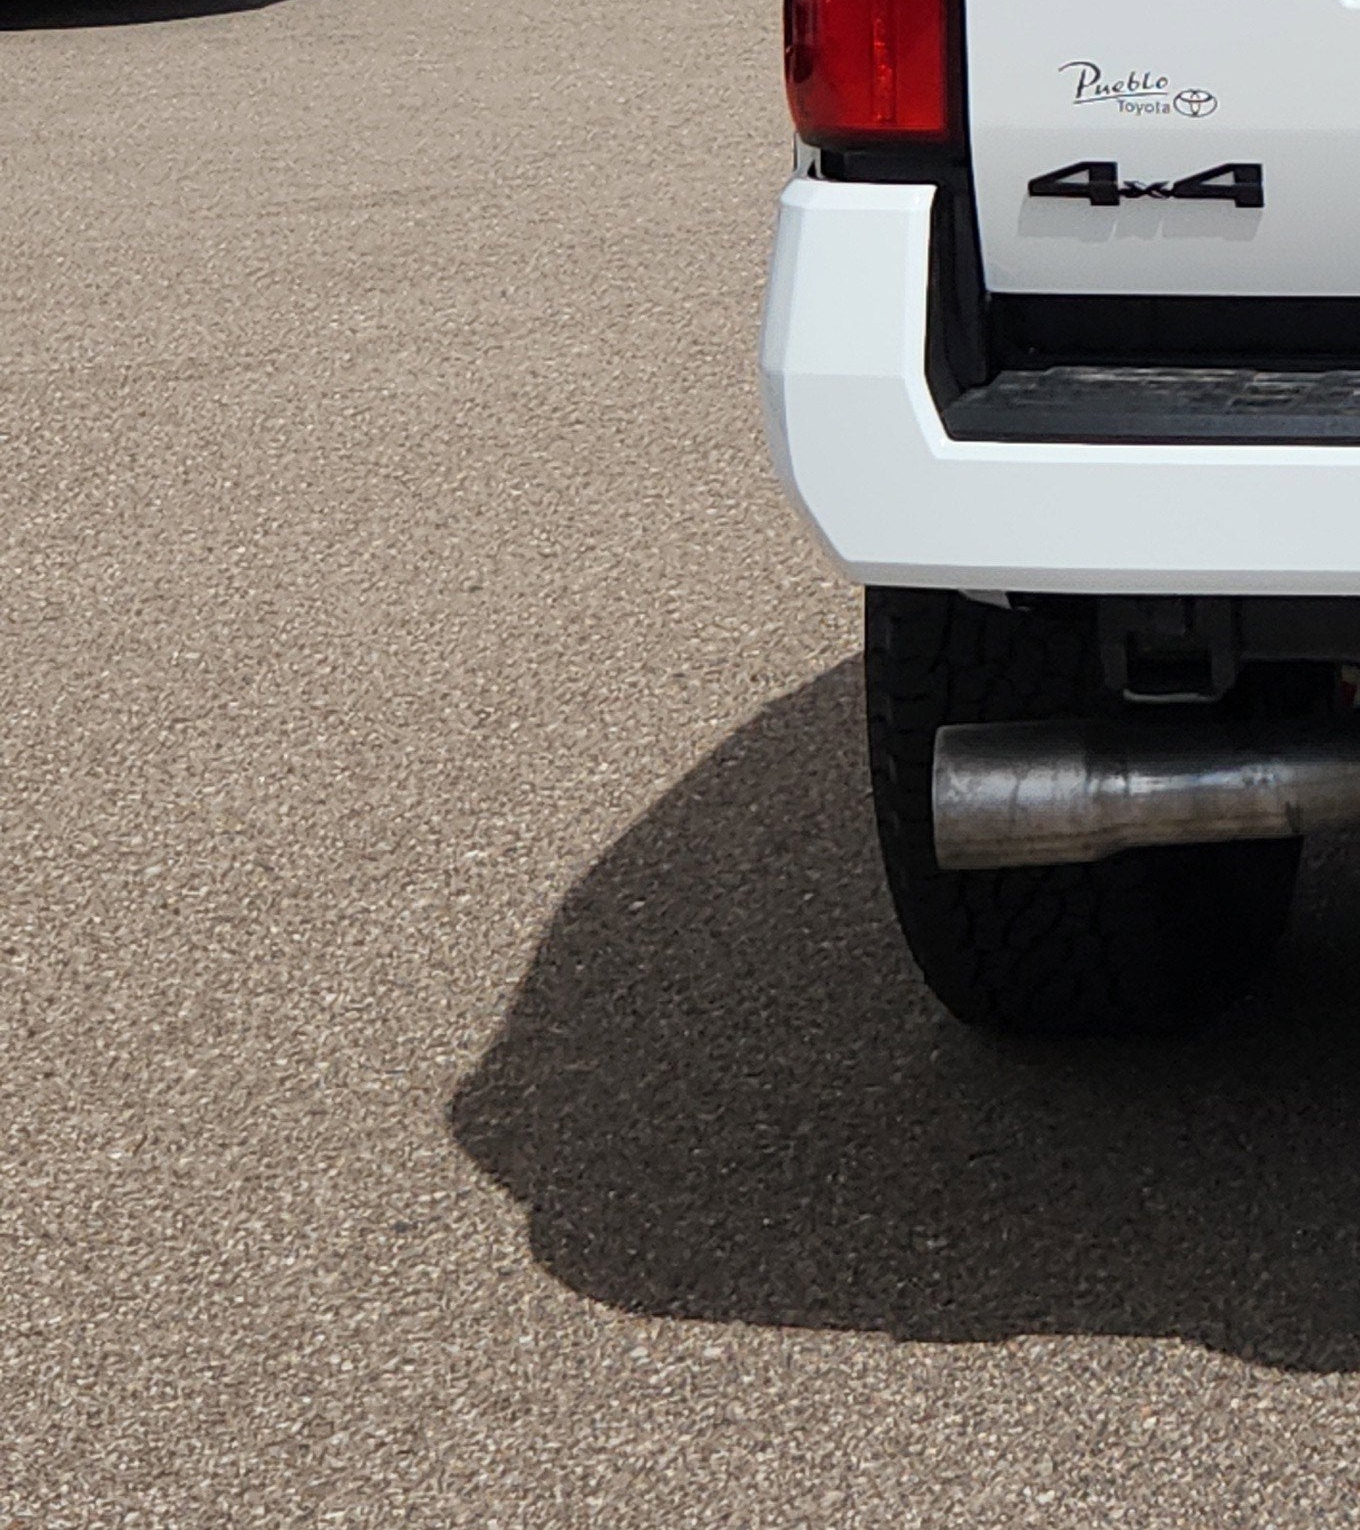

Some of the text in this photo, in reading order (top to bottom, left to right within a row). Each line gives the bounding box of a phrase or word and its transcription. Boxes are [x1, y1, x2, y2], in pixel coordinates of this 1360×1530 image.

[1058, 61, 1168, 98] Pueblo
[1117, 100, 1170, 115] Toyota
[1028, 161, 1265, 208] 4x4
